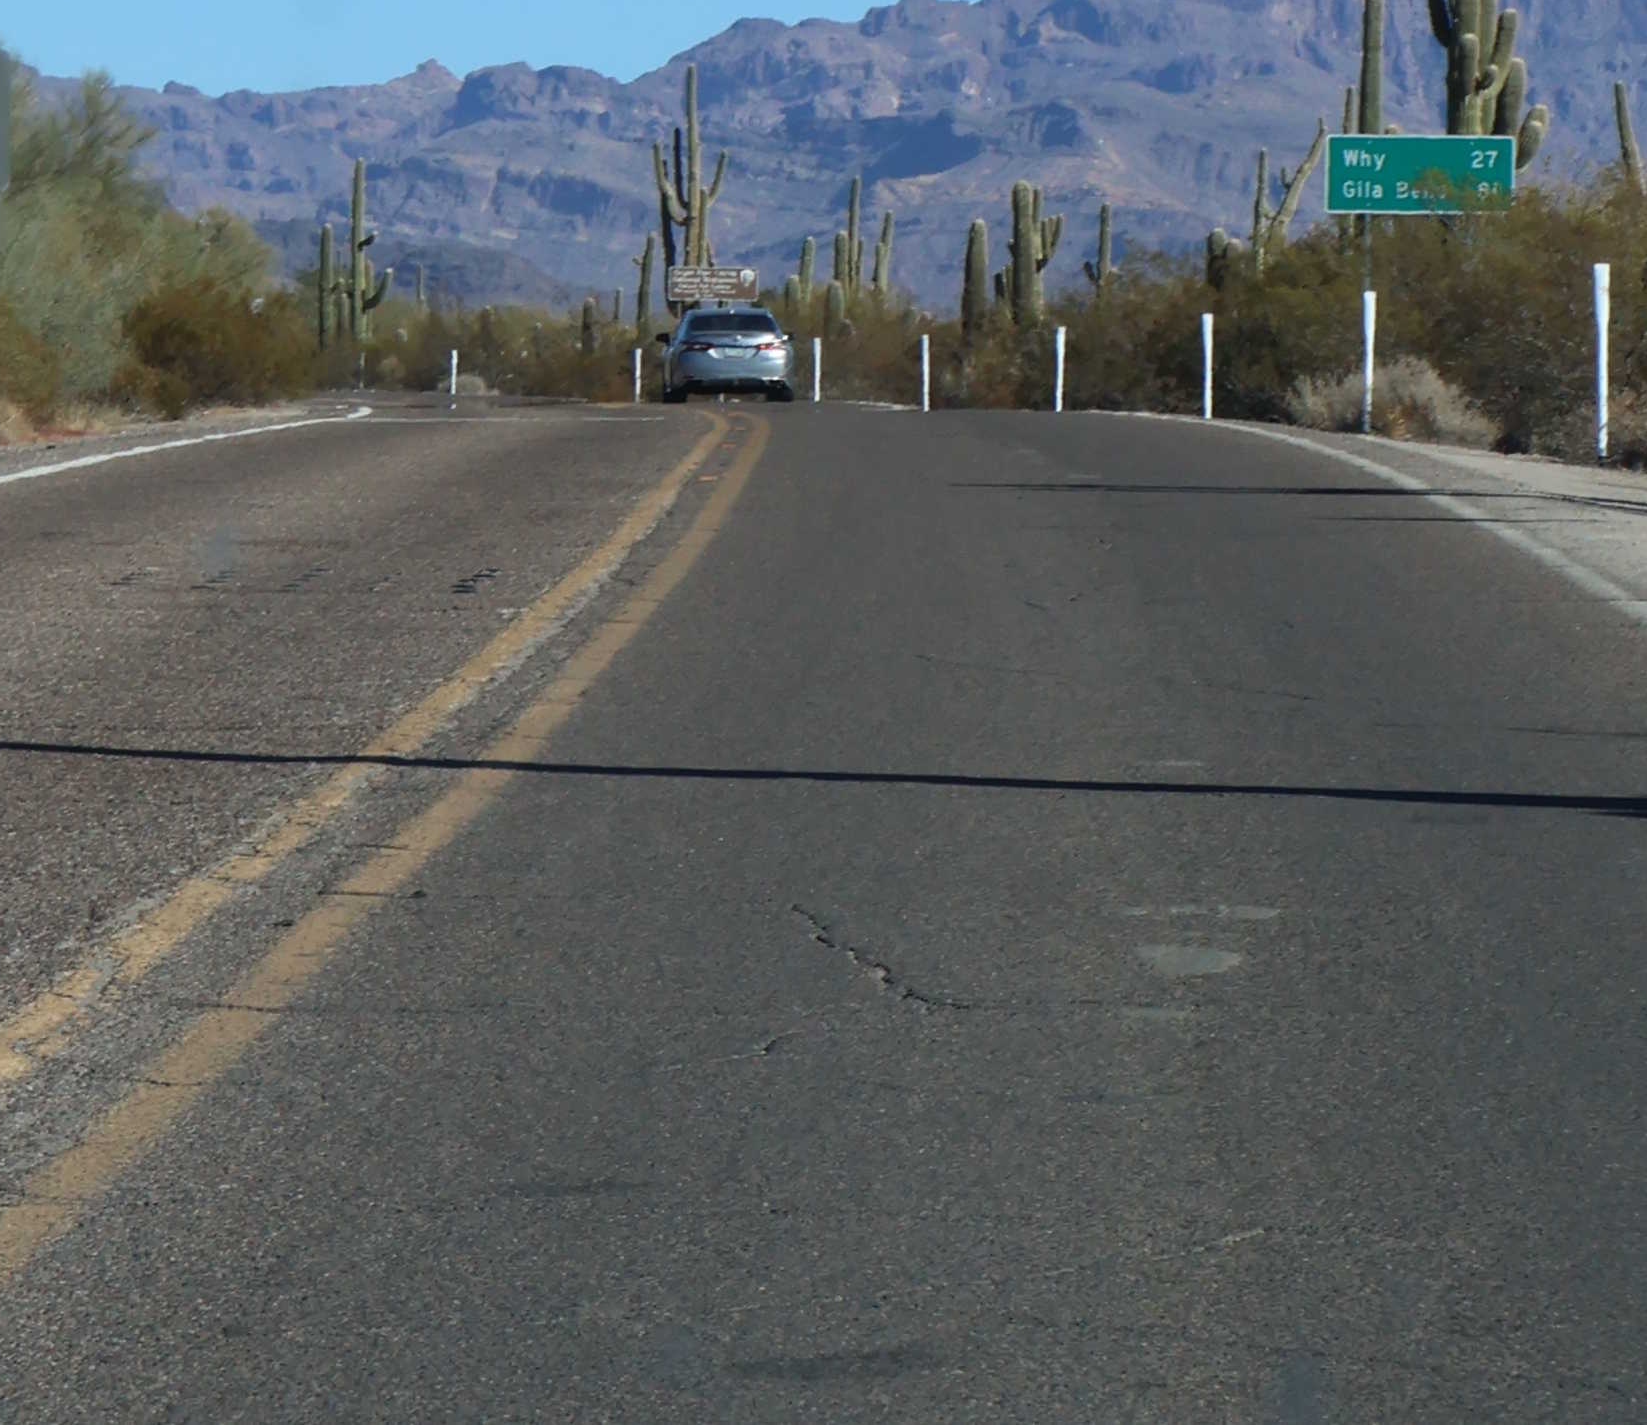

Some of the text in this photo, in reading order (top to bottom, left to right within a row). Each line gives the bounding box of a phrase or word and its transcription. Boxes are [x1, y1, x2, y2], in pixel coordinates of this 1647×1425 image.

[1342, 149, 1499, 171] Why 27
[1342, 180, 1384, 199] Gila
[1395, 181, 1448, 199] Be
